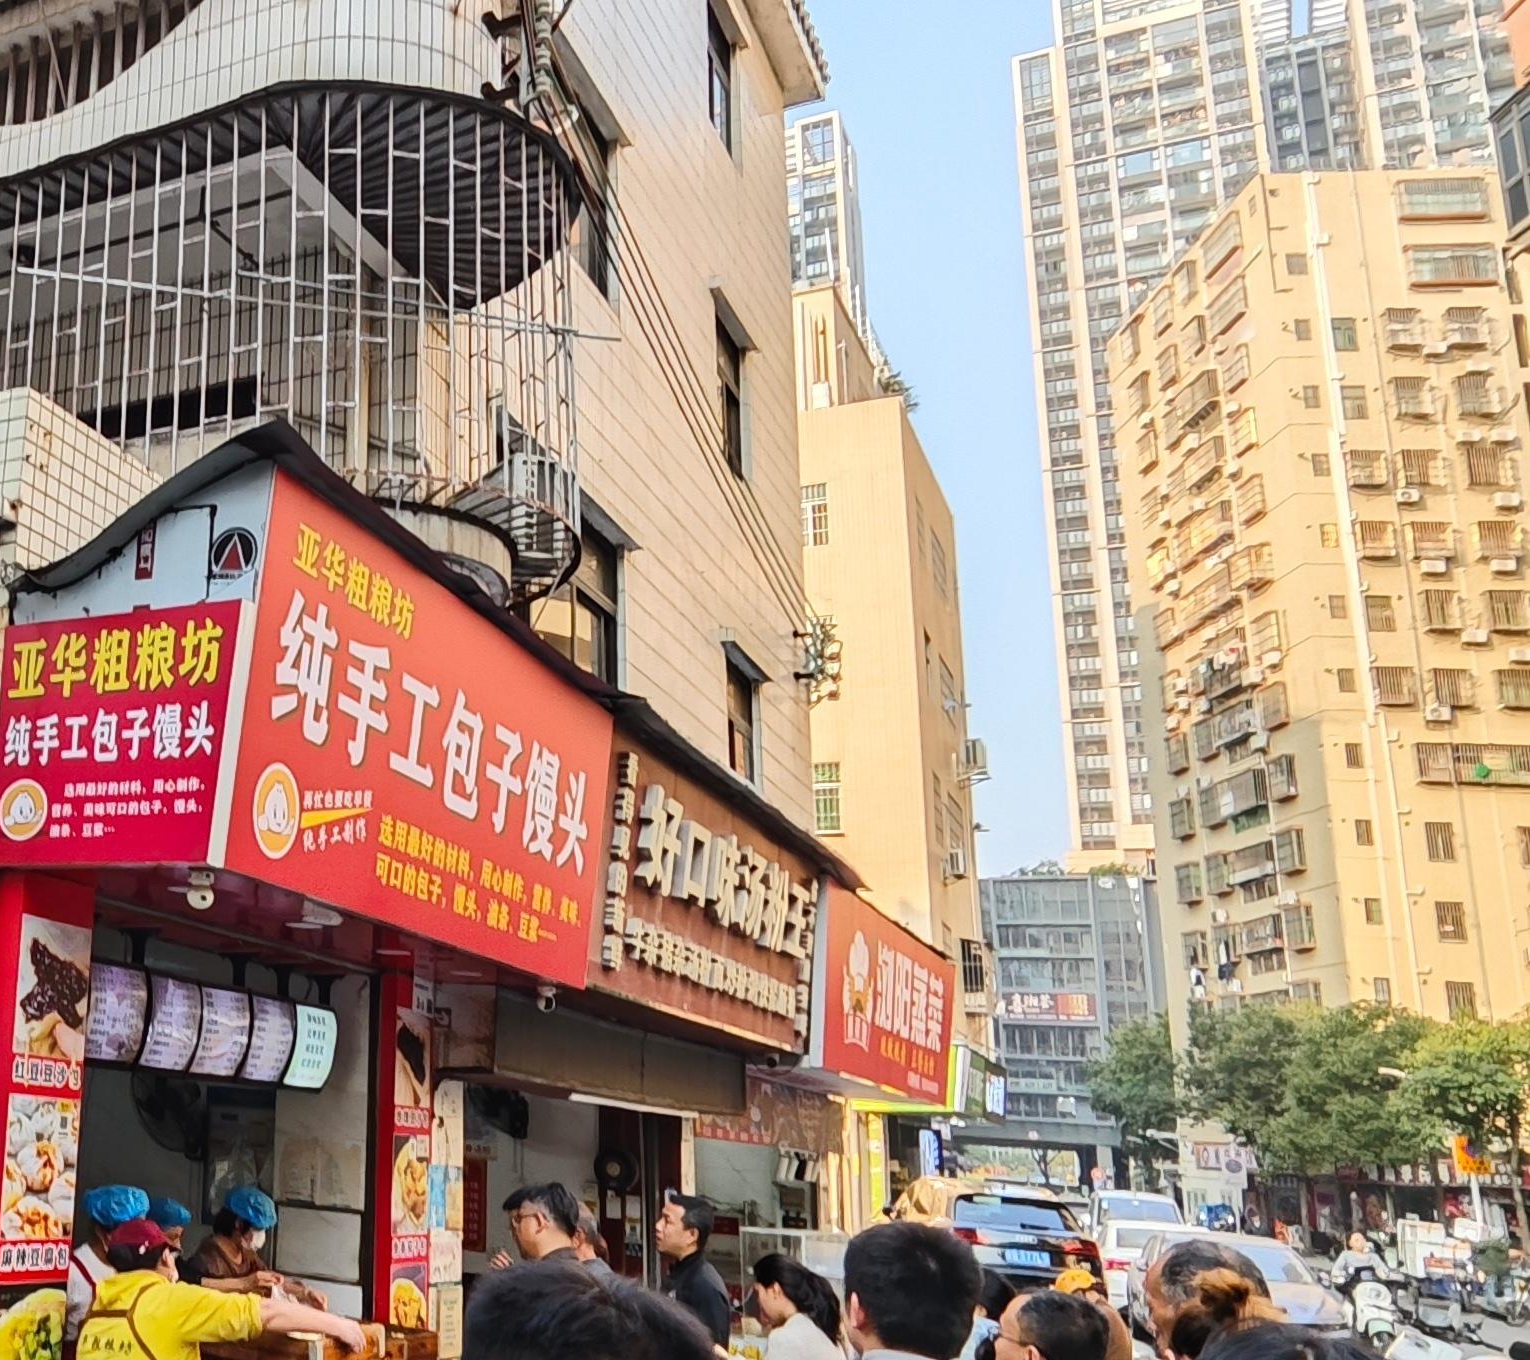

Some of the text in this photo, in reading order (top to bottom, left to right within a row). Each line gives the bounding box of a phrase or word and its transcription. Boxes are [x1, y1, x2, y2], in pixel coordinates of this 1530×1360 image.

[292, 522, 415, 640] 亚华粗粮坊
[7, 618, 225, 700] 亚华粗粮坊
[3, 700, 215, 767] 纯手工包子馒头
[271, 589, 590, 877] 纯手工包子馒头
[634, 784, 809, 960] 好口味汤粉王
[874, 939, 944, 1054] 浏阳蒸菜
[0, 1240, 71, 1273] 麻辣豆腐包
